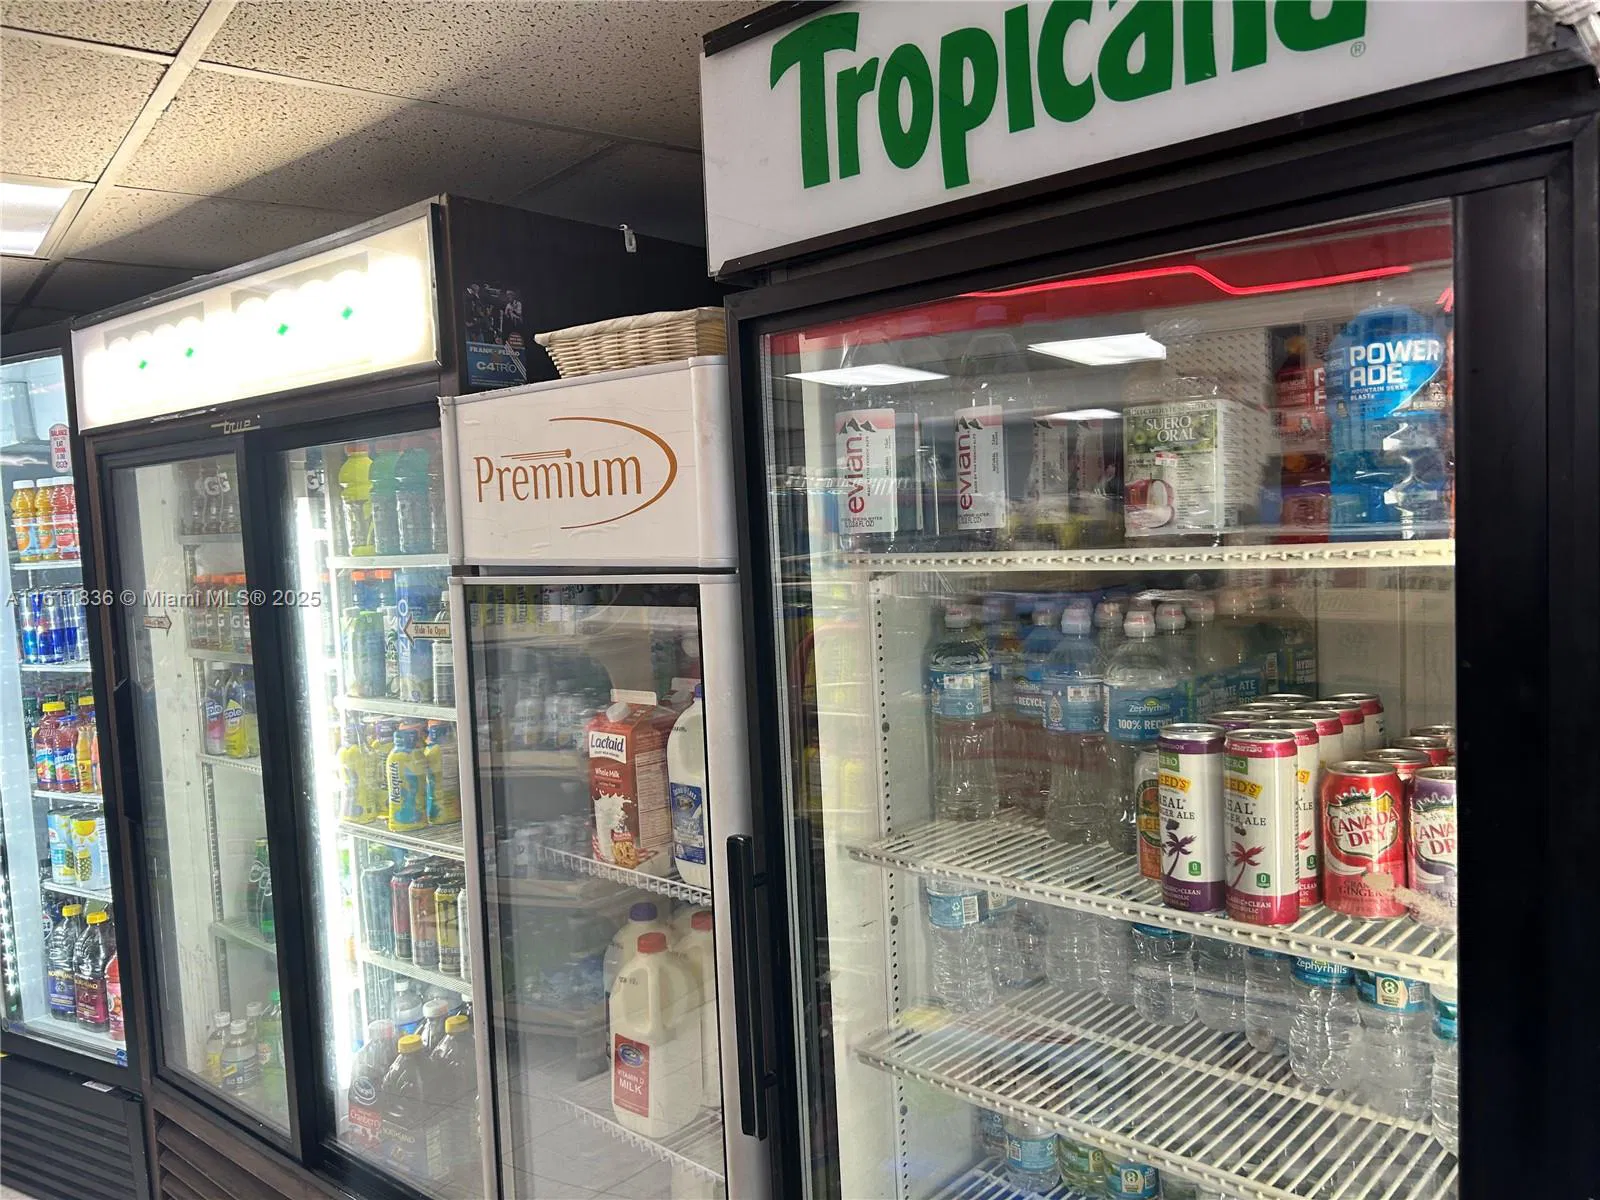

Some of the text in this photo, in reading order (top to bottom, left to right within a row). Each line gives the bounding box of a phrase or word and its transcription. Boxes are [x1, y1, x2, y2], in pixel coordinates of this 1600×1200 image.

[1350, 340, 1440, 367] POWER
[1350, 363, 1404, 388] ADE
[1146, 415, 1192, 430] SUERO
[1157, 427, 1197, 443] ORAL
[473, 449, 643, 503] Premium
[846, 436, 865, 514] evian
[958, 434, 973, 510] evian
[1118, 719, 1142, 730] 100%
[590, 732, 625, 753] Lactaid
[1159, 752, 1178, 766] ERO
[390, 760, 403, 804] Nesquik
[1159, 773, 1186, 791] EED'S
[1225, 777, 1259, 794] EED'S
[1177, 811, 1195, 820] ALE
[1224, 801, 1254, 815] EAL
[1245, 816, 1267, 826] ALE
[1328, 807, 1401, 838] CANADA
[1348, 826, 1387, 848] DRY
[1415, 820, 1456, 844] ANA
[1429, 839, 1456, 855] DR
[1296, 957, 1348, 975] Zephyrhills
[619, 1078, 642, 1096] MILK
